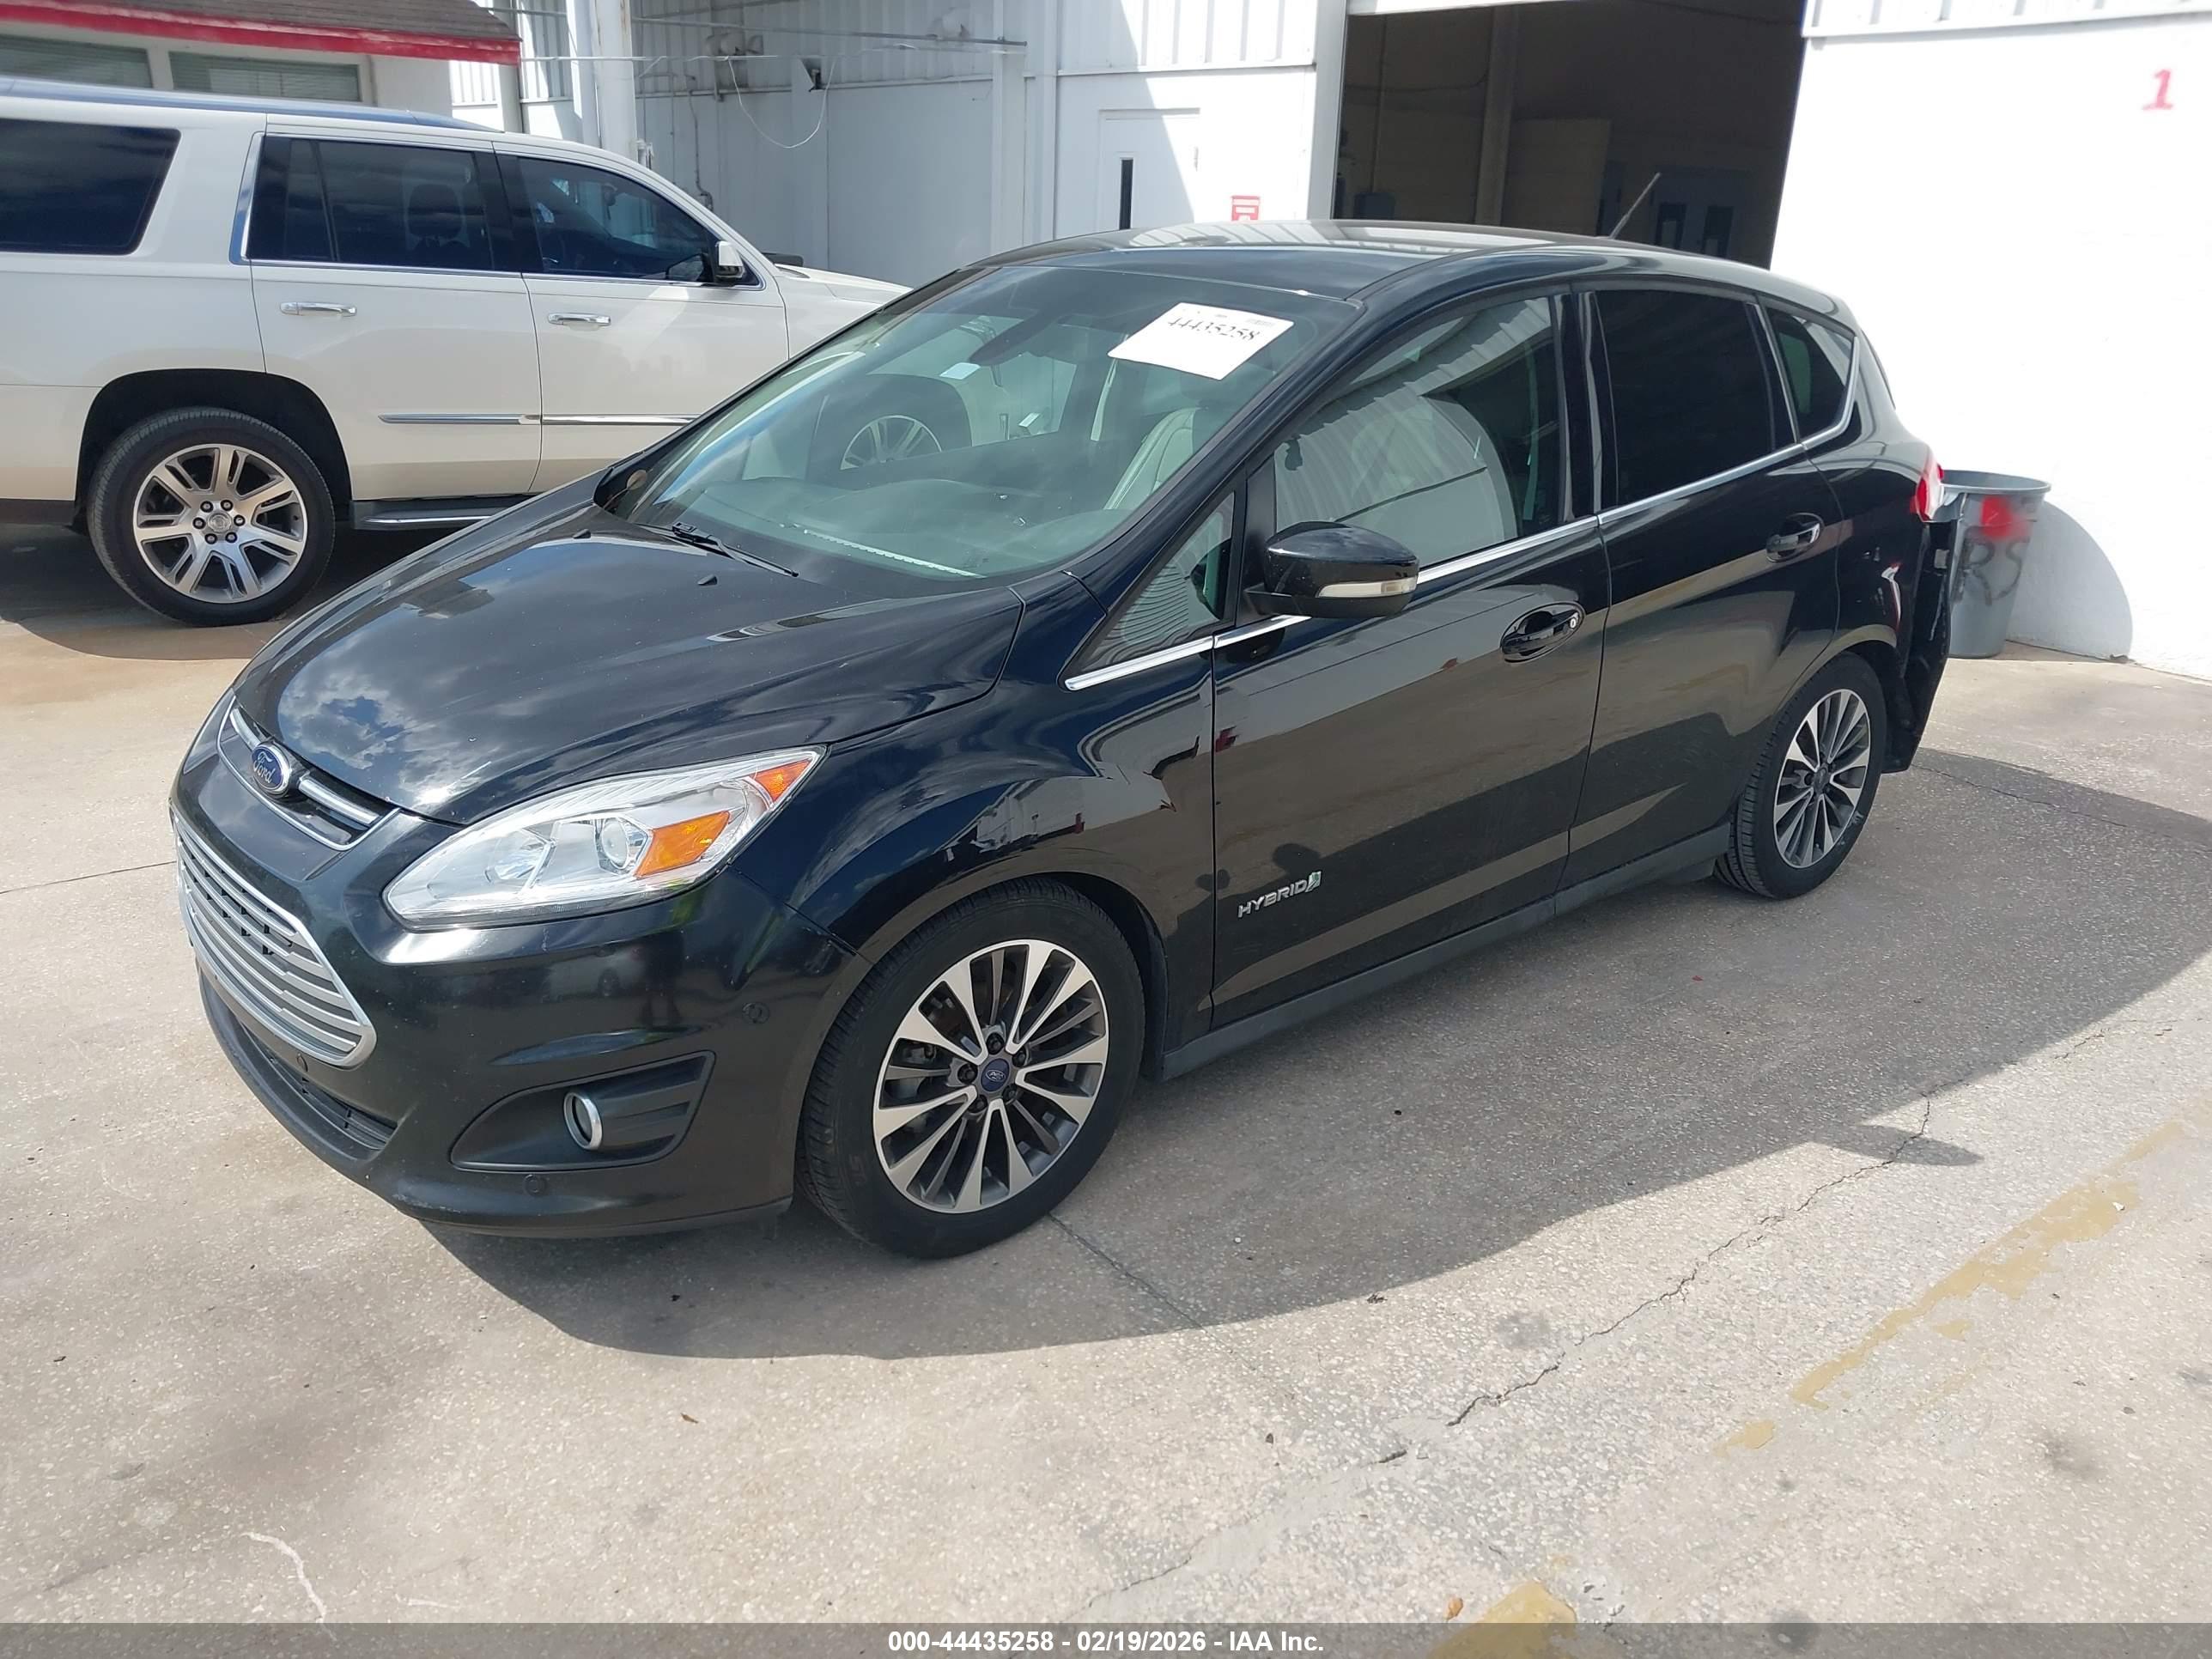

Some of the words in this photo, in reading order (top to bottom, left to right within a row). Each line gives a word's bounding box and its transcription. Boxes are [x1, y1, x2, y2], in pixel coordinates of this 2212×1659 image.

[2142, 69, 2173, 111] 1
[1167, 316, 1261, 341] 44435258
[252, 750, 276, 784] Ford
[1237, 878, 1308, 918] HYBRID
